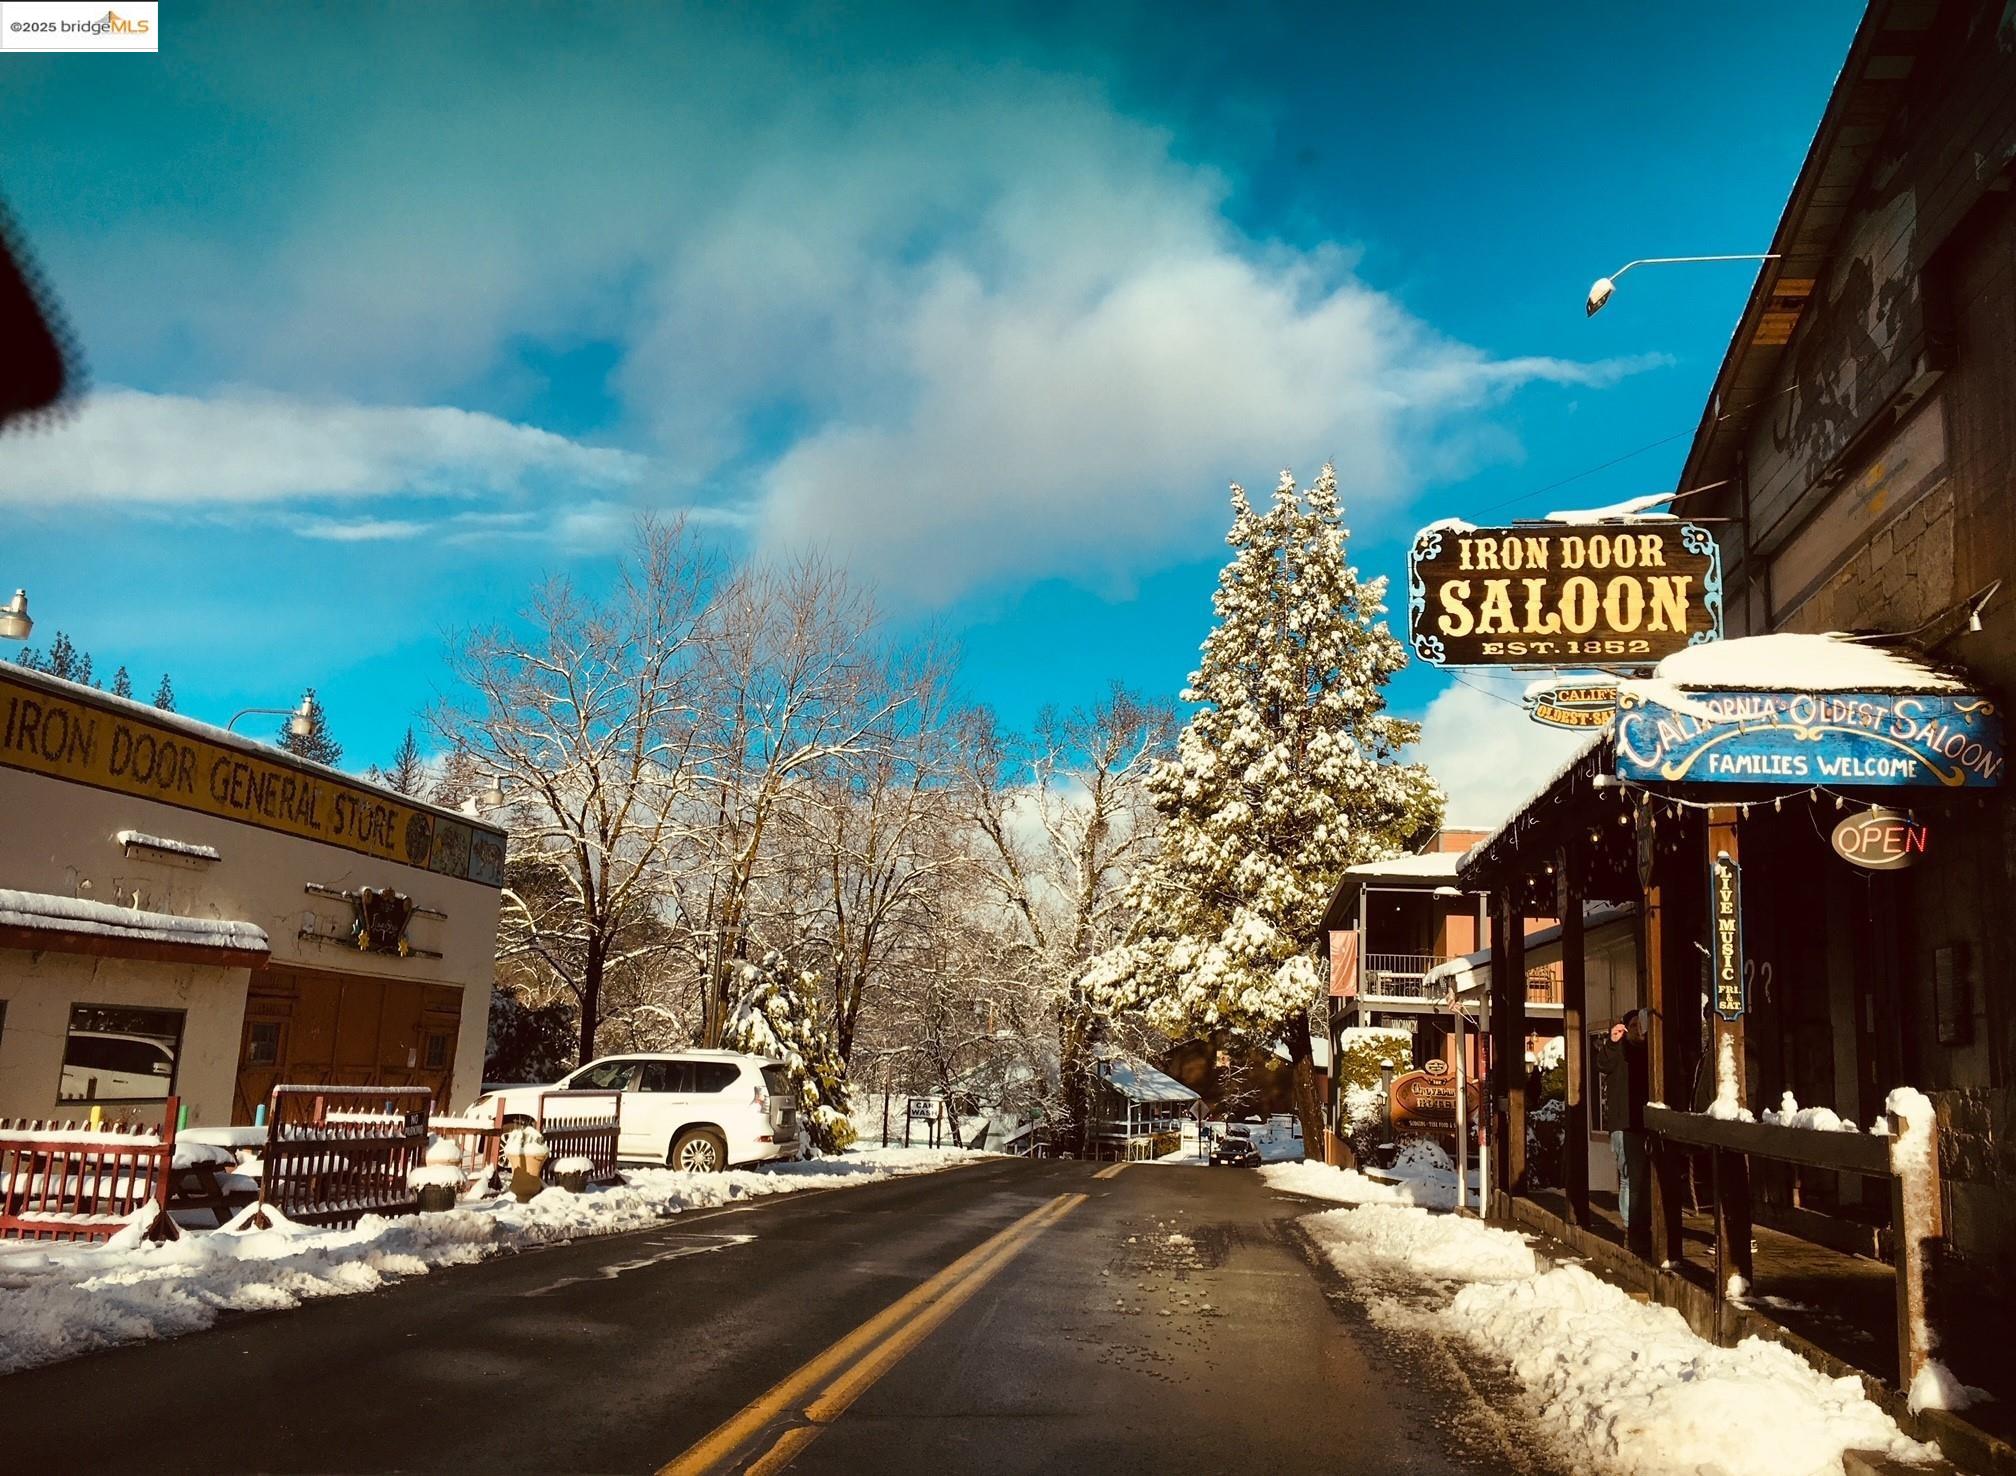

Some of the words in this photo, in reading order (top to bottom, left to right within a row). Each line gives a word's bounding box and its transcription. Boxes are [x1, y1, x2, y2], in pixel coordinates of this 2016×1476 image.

[1459, 535, 1549, 570] IRON
[1560, 534, 1666, 568] DOOR
[1438, 575, 1692, 637] SALOON
[1790, 695, 1889, 730] OLDEST
[1890, 699, 2003, 779] SALOON
[4, 697, 96, 768] IRON
[108, 724, 197, 794] DOOR
[209, 756, 321, 830] GENERAL
[333, 792, 399, 849] STORE
[1709, 753, 1808, 775] FAMILIES
[1817, 756, 1917, 778] WELCOME
[1838, 827, 1927, 853] OPEN
[1720, 866, 1733, 914] LIVE
[1718, 919, 1737, 980] MUSIC
